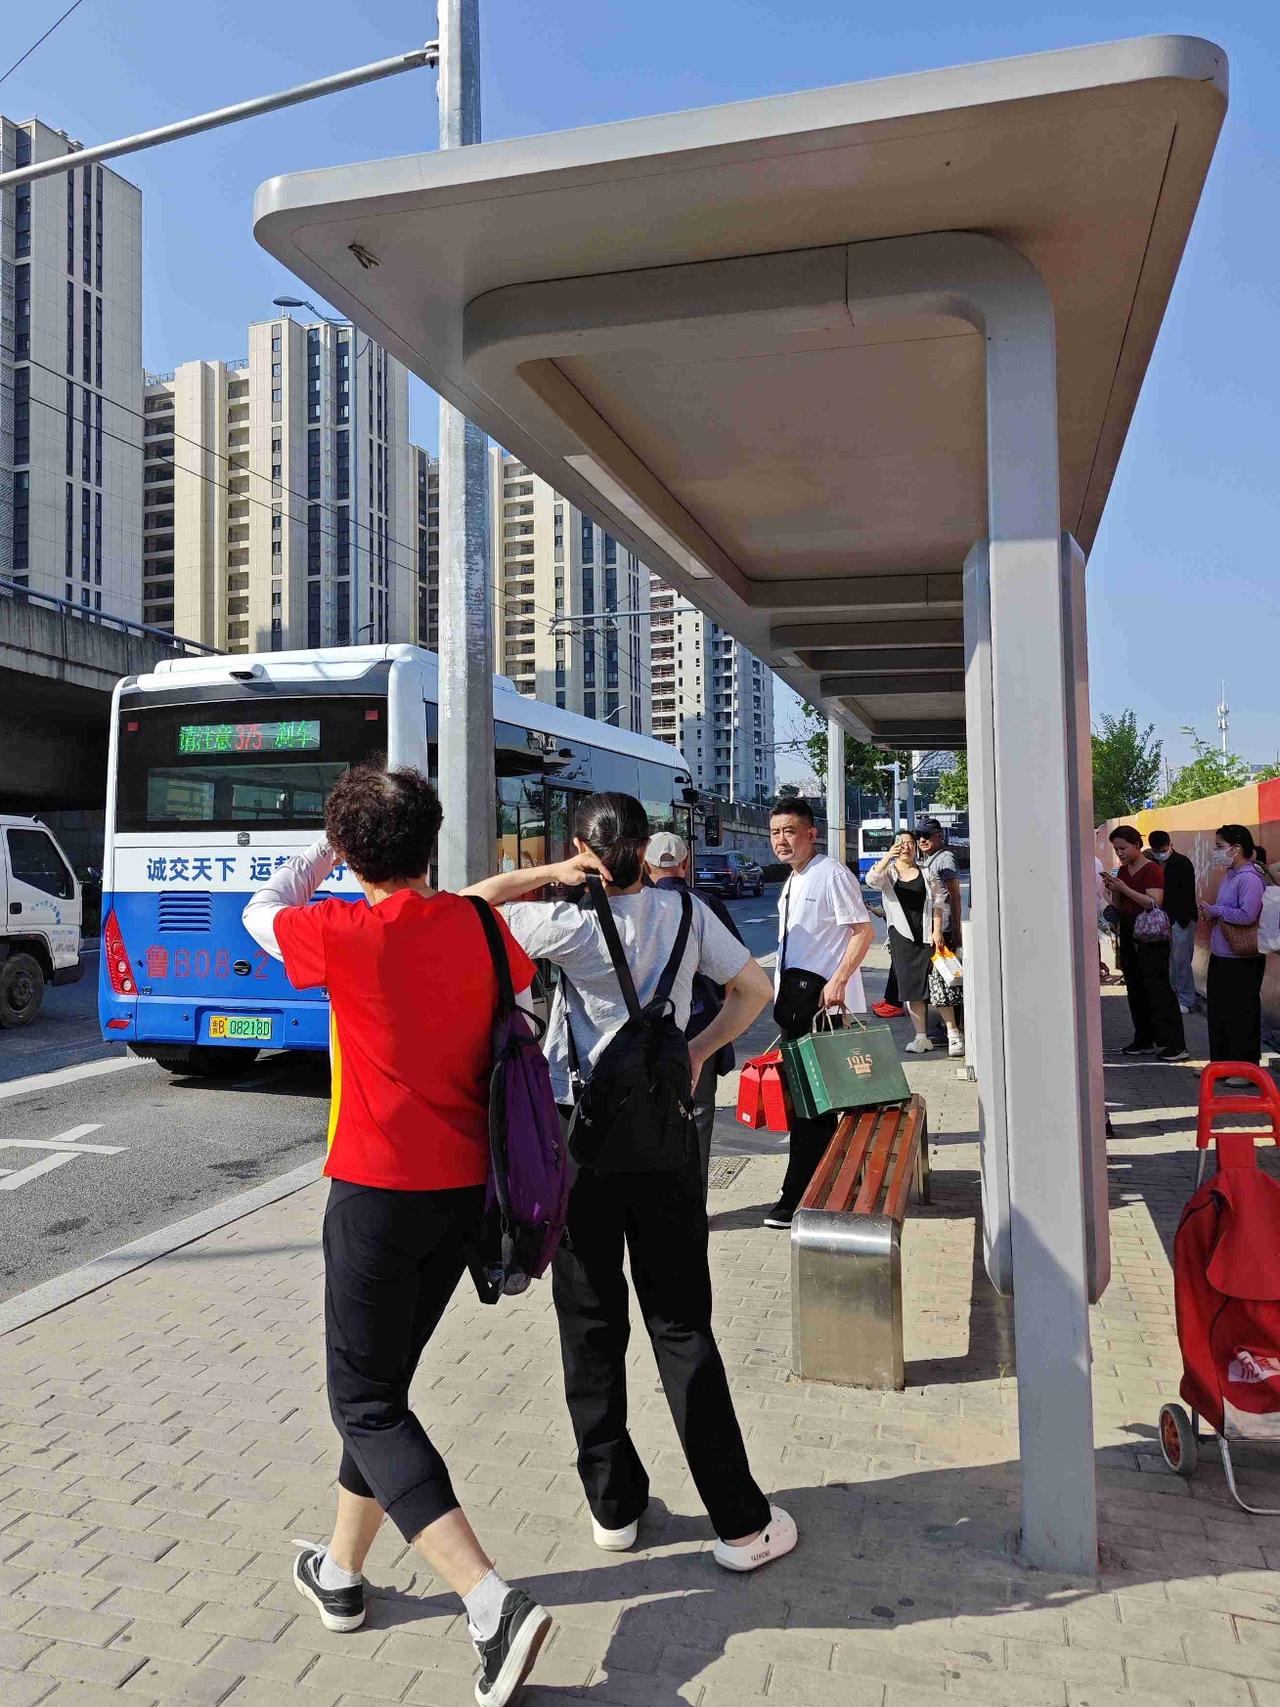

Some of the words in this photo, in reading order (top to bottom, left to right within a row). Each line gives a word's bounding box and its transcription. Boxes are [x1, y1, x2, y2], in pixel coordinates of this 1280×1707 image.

[235, 724, 262, 751] 375
[146, 856, 237, 882] 诚交天下
[847, 1054, 873, 1070] 1915
